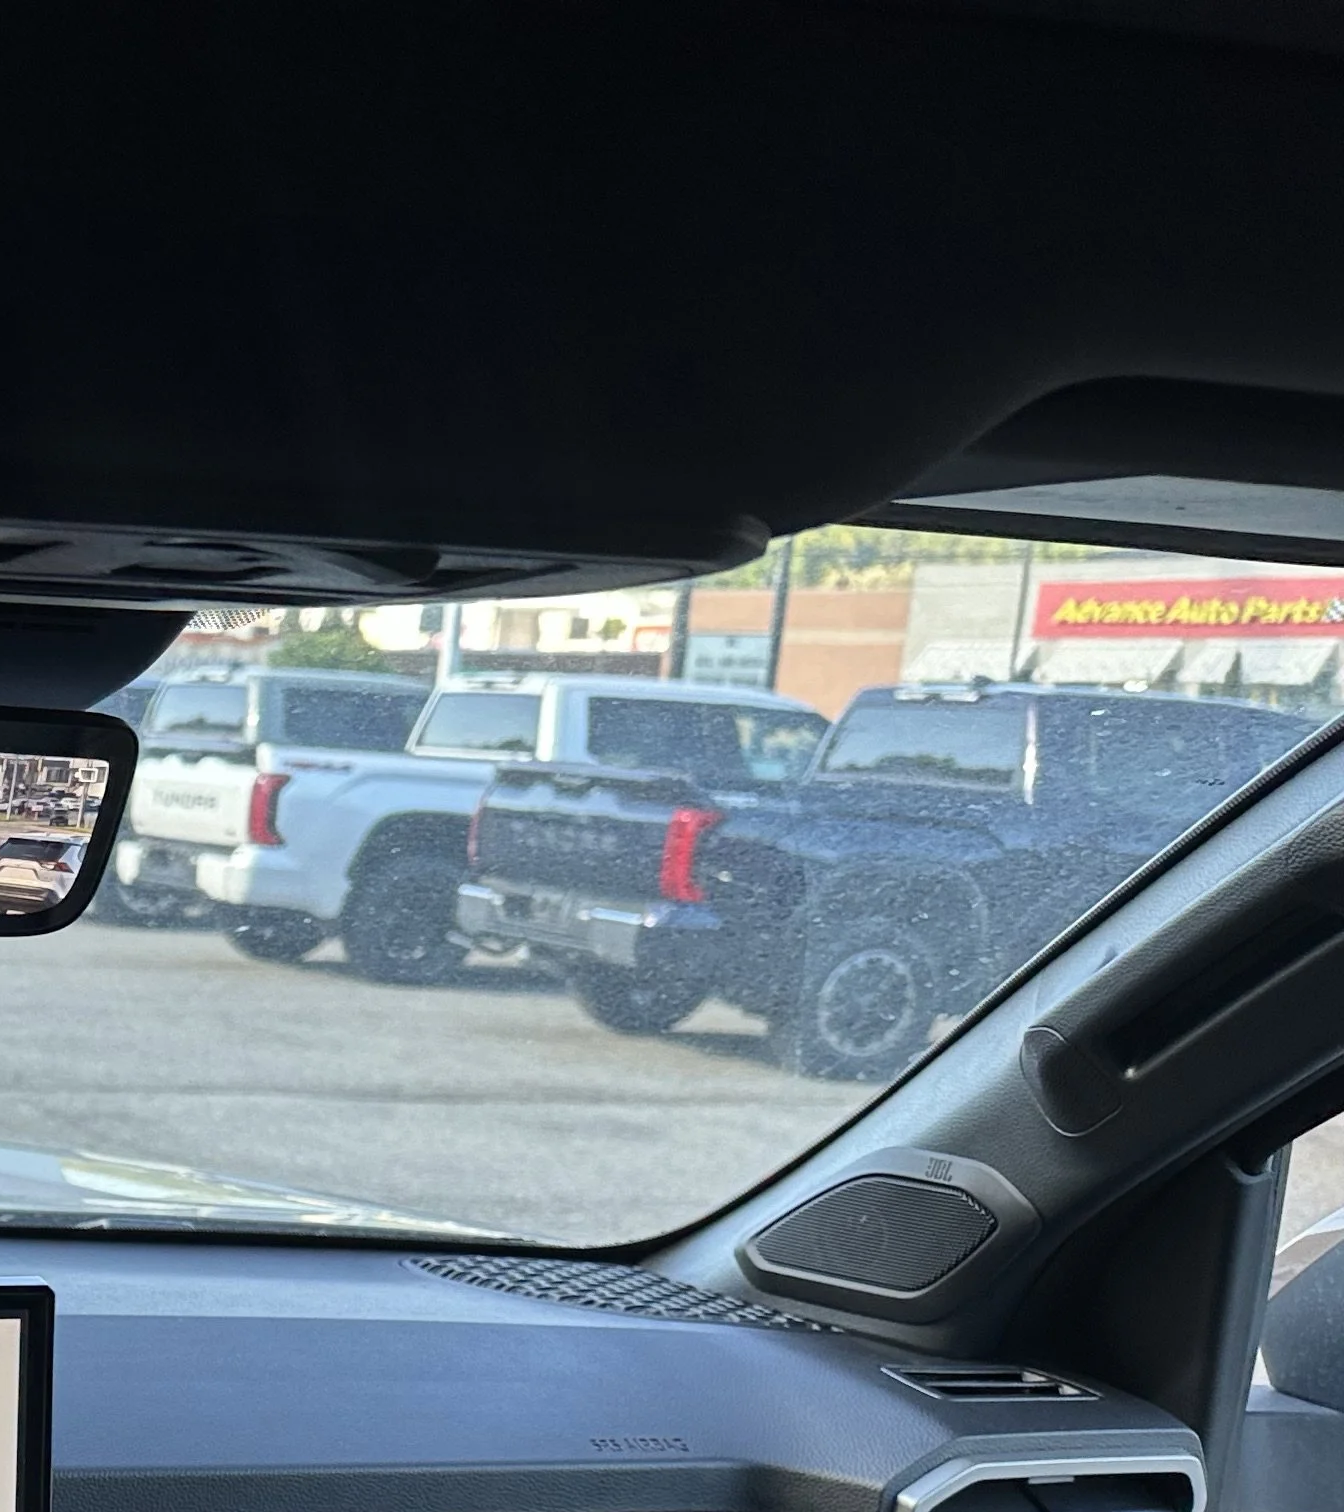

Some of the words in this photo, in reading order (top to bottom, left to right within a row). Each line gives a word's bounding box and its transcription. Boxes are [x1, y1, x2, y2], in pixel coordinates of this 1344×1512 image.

[1051, 596, 1167, 625] Advance
[1165, 596, 1240, 626] Auto
[1241, 595, 1326, 625] Parts
